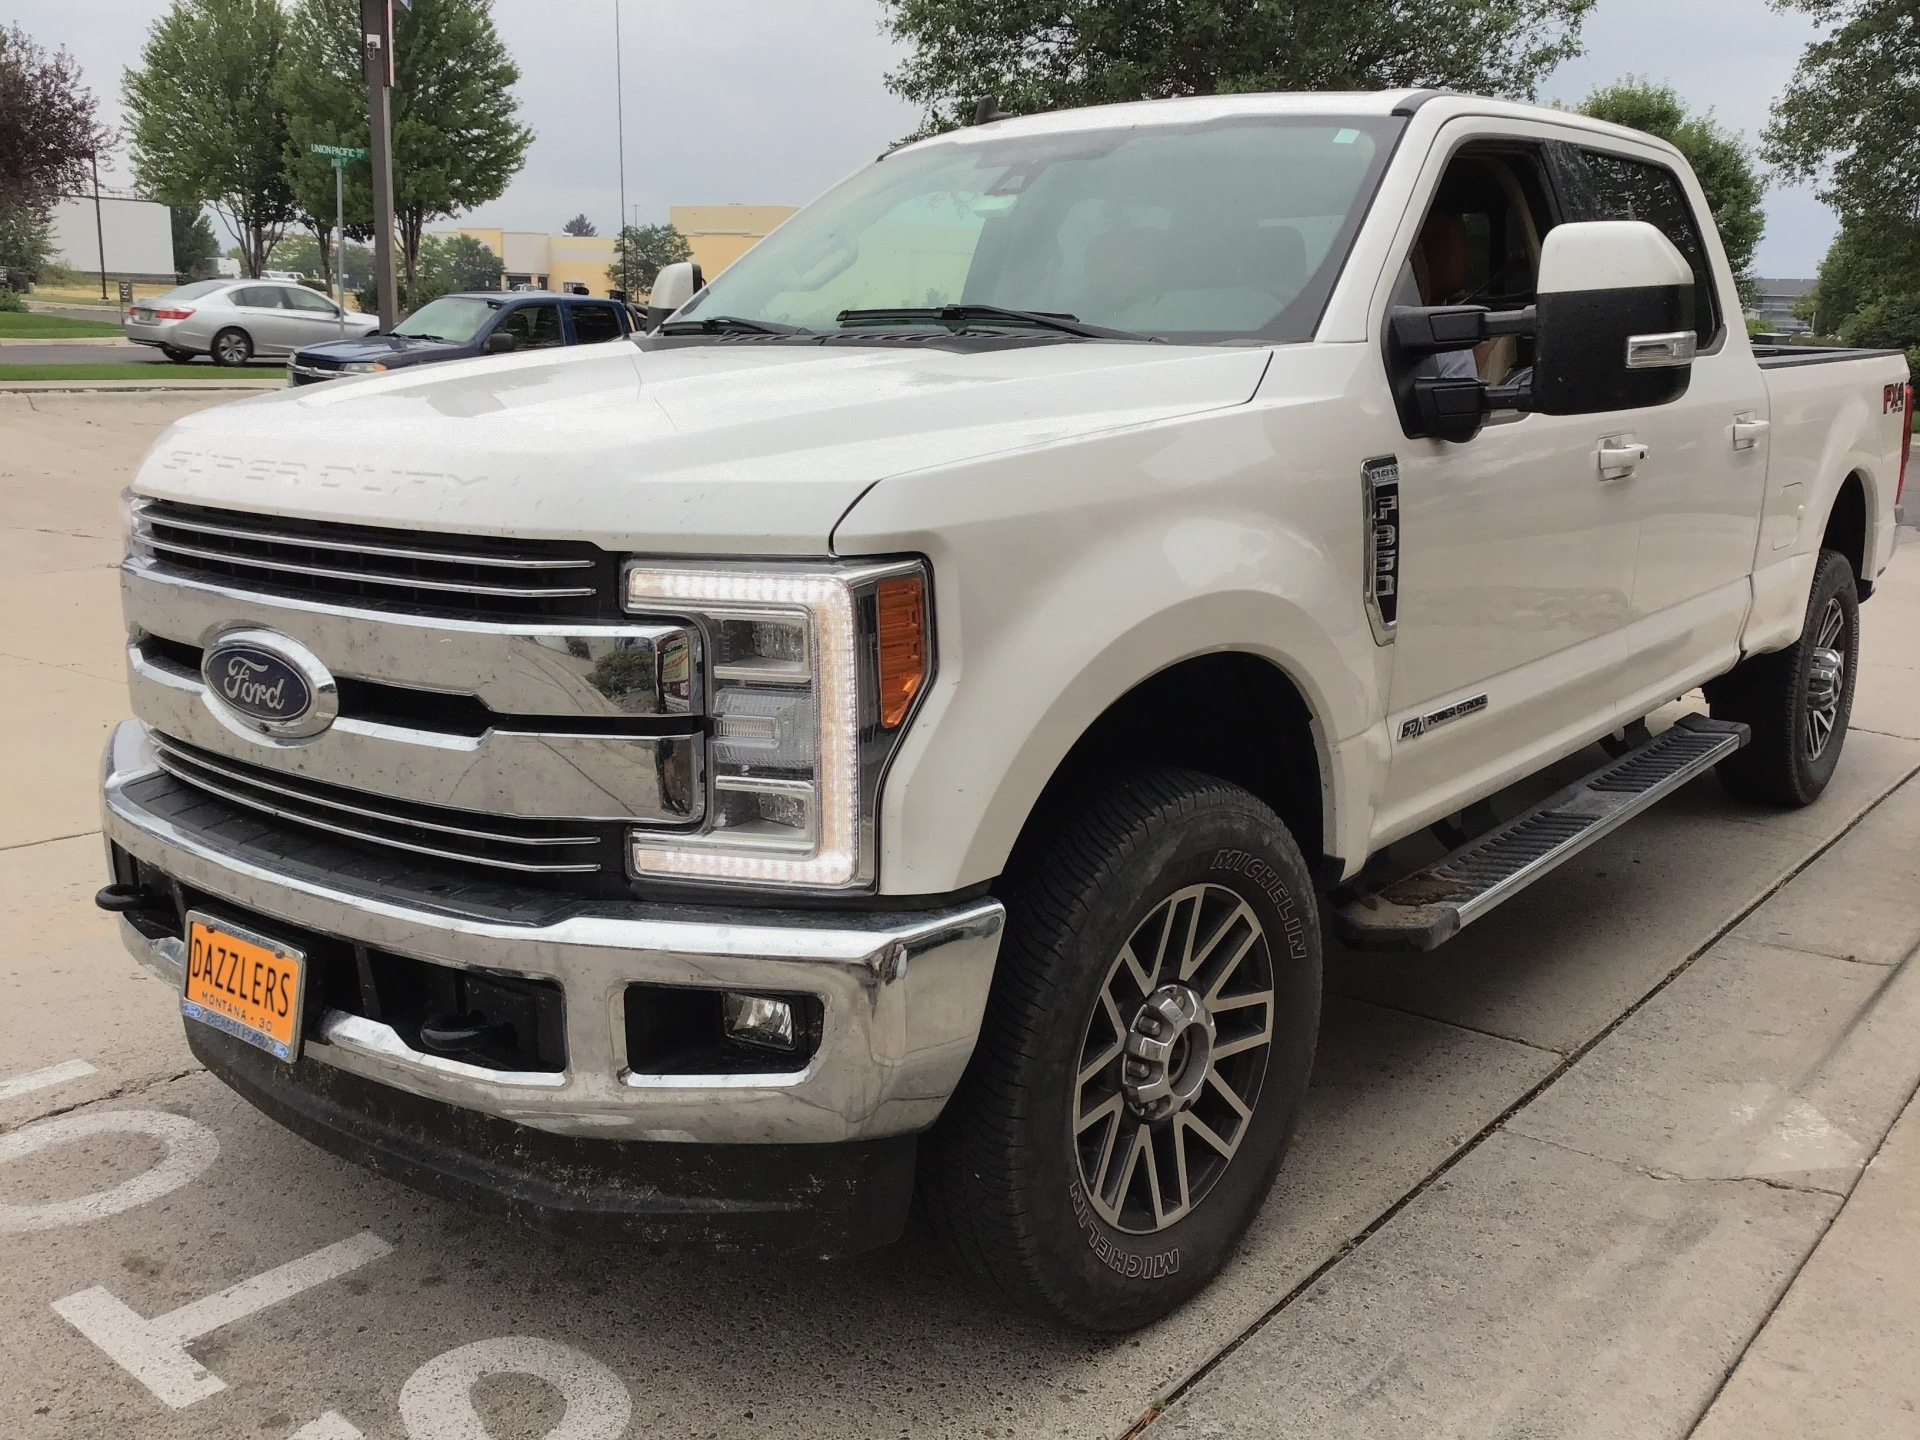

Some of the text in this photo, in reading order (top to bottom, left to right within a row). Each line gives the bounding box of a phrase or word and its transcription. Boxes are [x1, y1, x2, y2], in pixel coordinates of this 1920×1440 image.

[311, 144, 331, 155] UNION
[331, 146, 355, 158] PACIFIC
[1883, 382, 1904, 414] FX4
[223, 656, 285, 709] Ford
[1209, 849, 1307, 959] MICHELIN
[192, 938, 290, 1018] DAZZLERS
[201, 991, 247, 1020] MONTANA
[1070, 1180, 1179, 1279] MICHELIN
